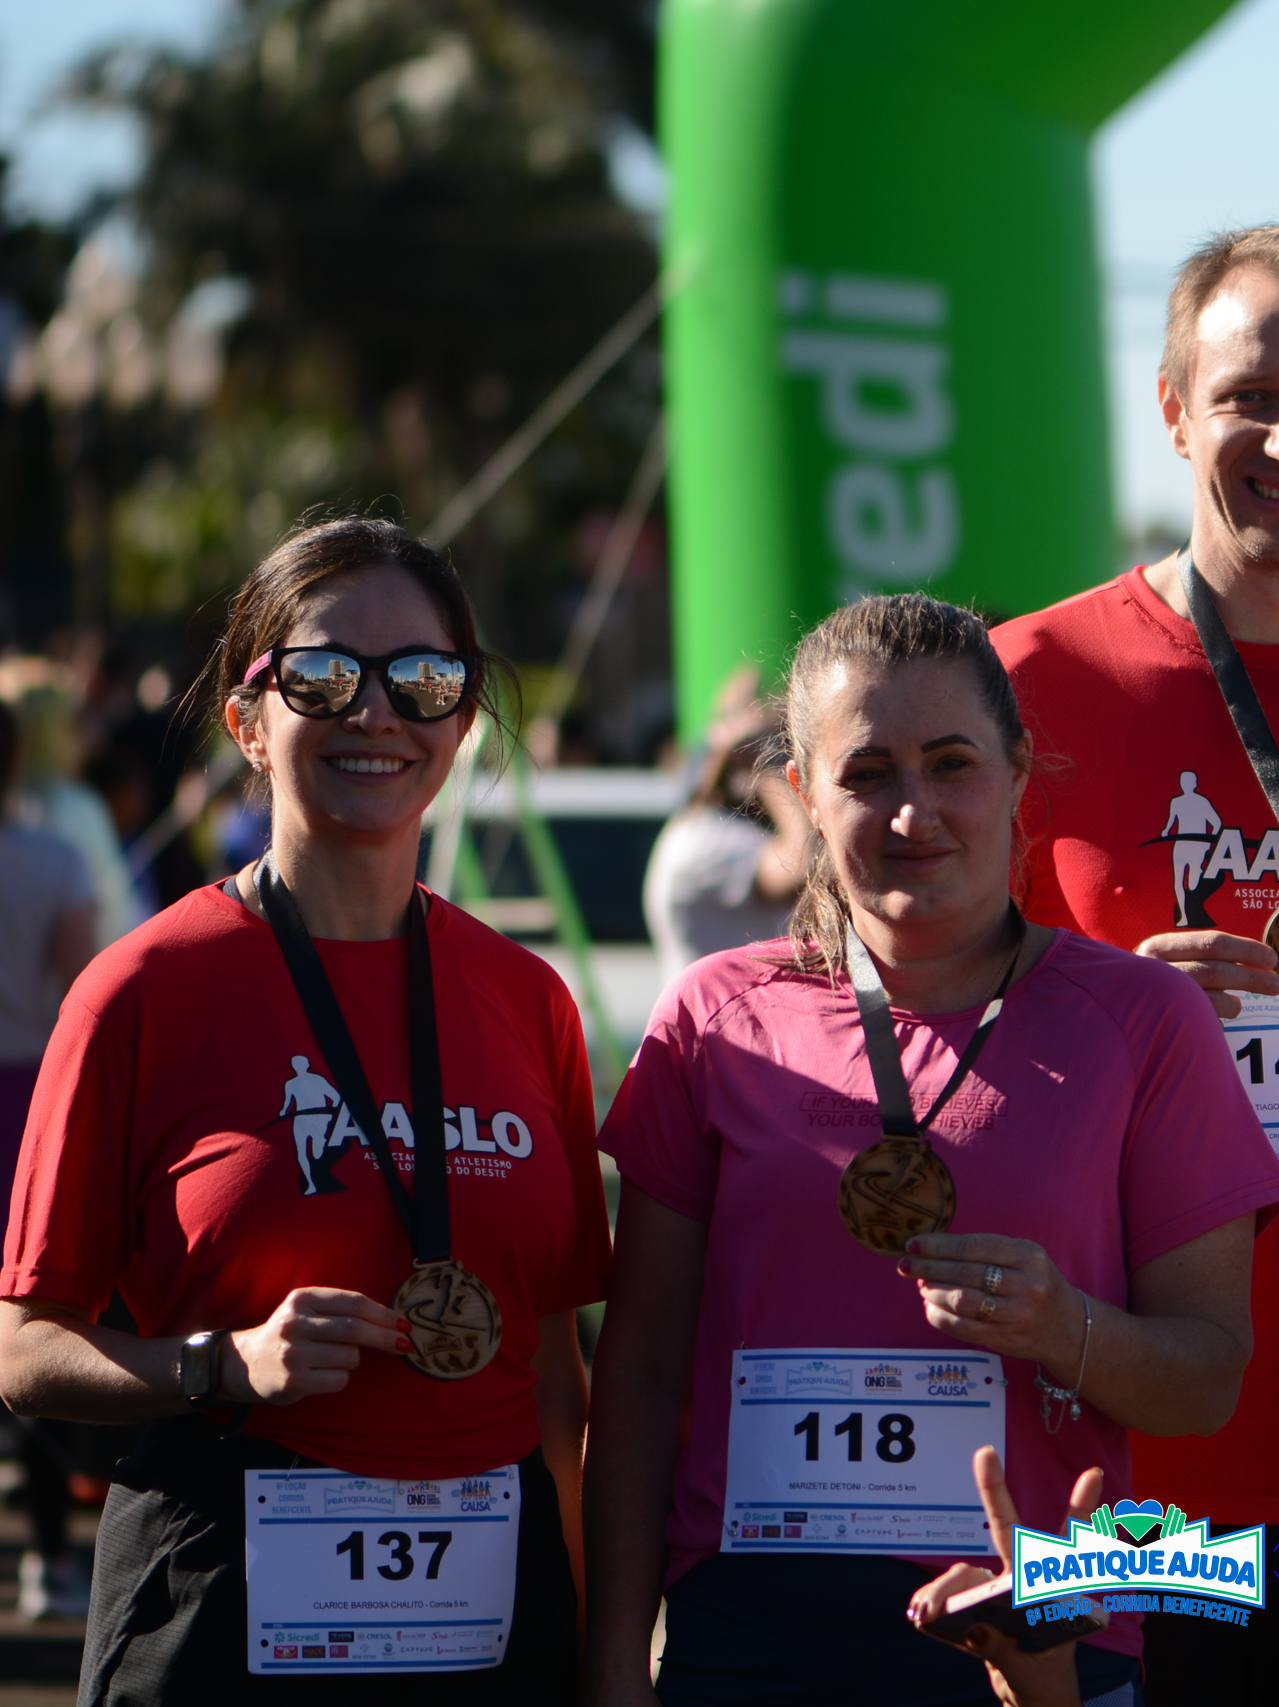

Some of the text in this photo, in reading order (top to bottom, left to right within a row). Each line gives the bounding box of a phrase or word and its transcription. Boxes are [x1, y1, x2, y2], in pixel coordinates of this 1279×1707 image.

[1243, 898, 1263, 909] SÃO
[1242, 1004, 1263, 1013] TIQUE
[1255, 1103, 1279, 1111] TIAGO
[858, 1114, 882, 1127] BO
[454, 1156, 512, 1169] ATLETISMO
[456, 1166, 470, 1175] DO
[475, 1167, 507, 1179] OESTE
[865, 1376, 886, 1388] ONG
[927, 1385, 968, 1397] CAUSA
[794, 1412, 916, 1463] 118
[789, 1482, 828, 1490] MARIZETE
[830, 1482, 861, 1491] DETONI
[868, 1483, 896, 1492] Corrida
[905, 1484, 917, 1492] km
[327, 1495, 392, 1506] PRATIQUE AJUDA
[407, 1493, 426, 1506] ONG
[460, 1501, 492, 1512] CAUSA
[336, 1530, 452, 1581] 137
[313, 1601, 349, 1610] CLARICE
[351, 1601, 390, 1609] BARBOSA
[391, 1600, 424, 1609] CHALITO
[429, 1600, 453, 1608] Corrida
[454, 1600, 459, 1608] 5
[460, 1599, 469, 1608] km
[287, 1633, 320, 1642] Sicredi
